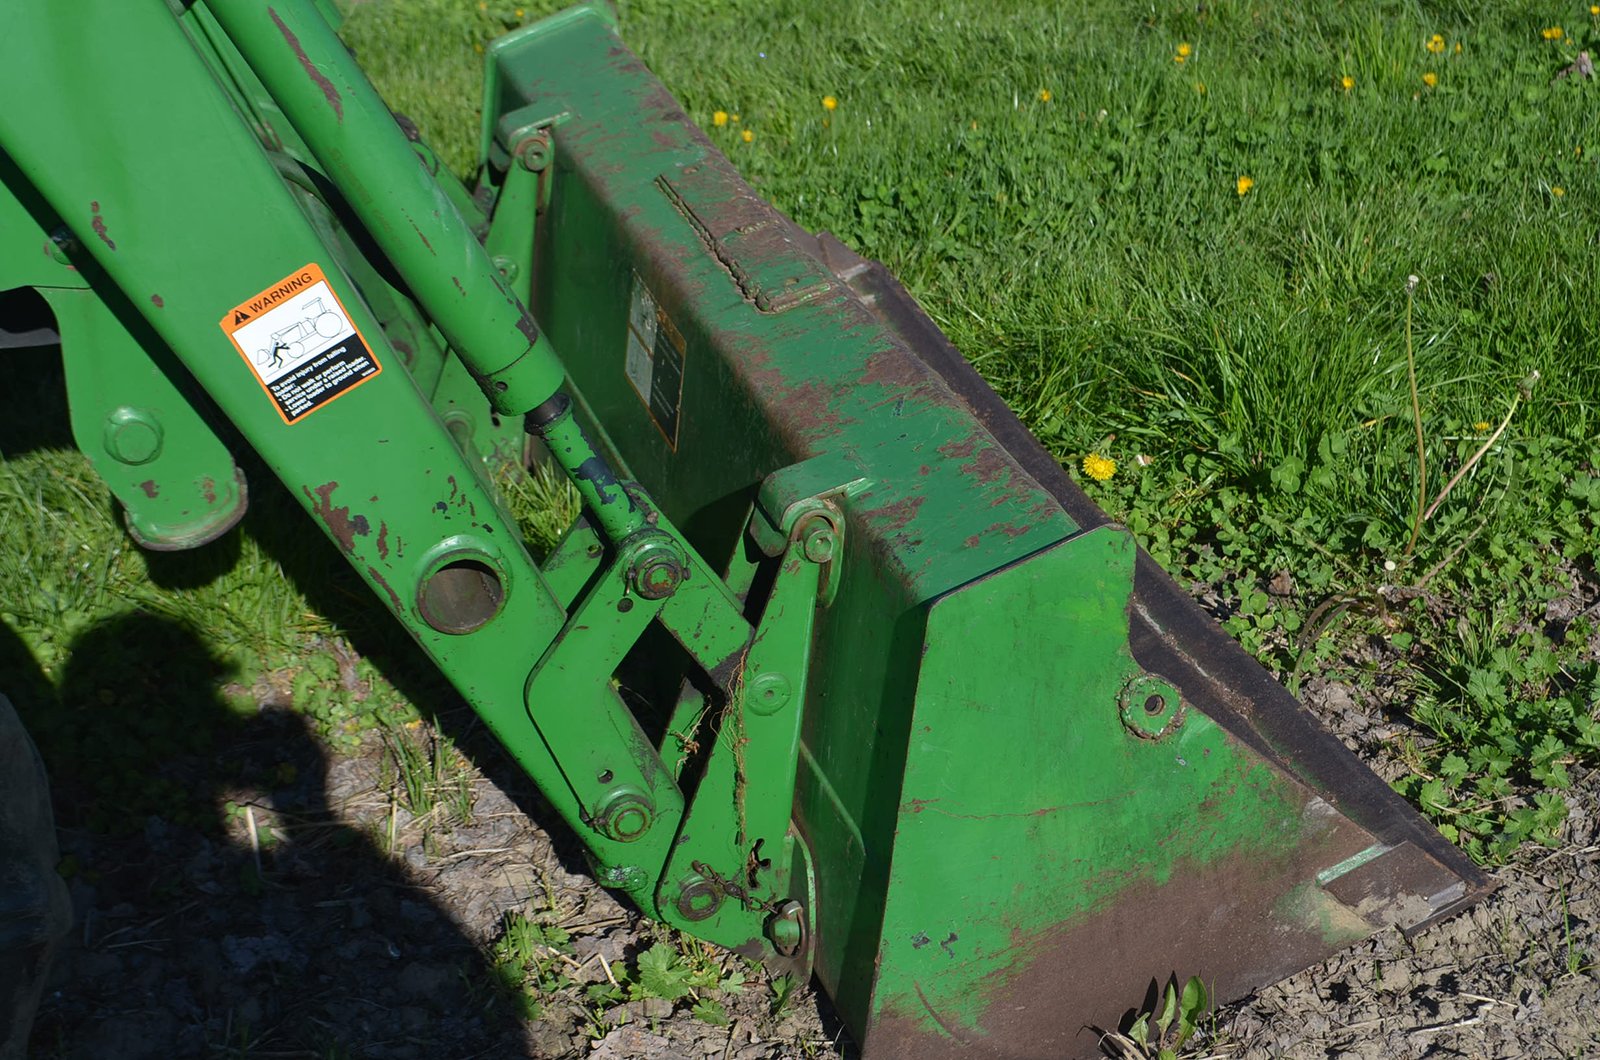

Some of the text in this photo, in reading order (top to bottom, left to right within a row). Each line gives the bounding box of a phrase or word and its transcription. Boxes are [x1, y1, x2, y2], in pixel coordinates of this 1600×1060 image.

[249, 272, 312, 313] WARNING
[279, 375, 297, 387] avoid
[295, 365, 313, 378] injury
[312, 357, 328, 368] from
[326, 346, 346, 359] falling
[284, 391, 307, 406] service
[305, 380, 323, 393] under
[327, 366, 346, 380] raised
[345, 356, 366, 369] loader.
[288, 397, 307, 410] Lower
[306, 386, 325, 399] loader
[332, 369, 353, 385] ground
[352, 361, 369, 372] when
[291, 386, 302, 395] not
[301, 378, 316, 388] walk
[322, 361, 347, 377] perform
[274, 383, 296, 397] loader:
[291, 400, 313, 416] parked.
